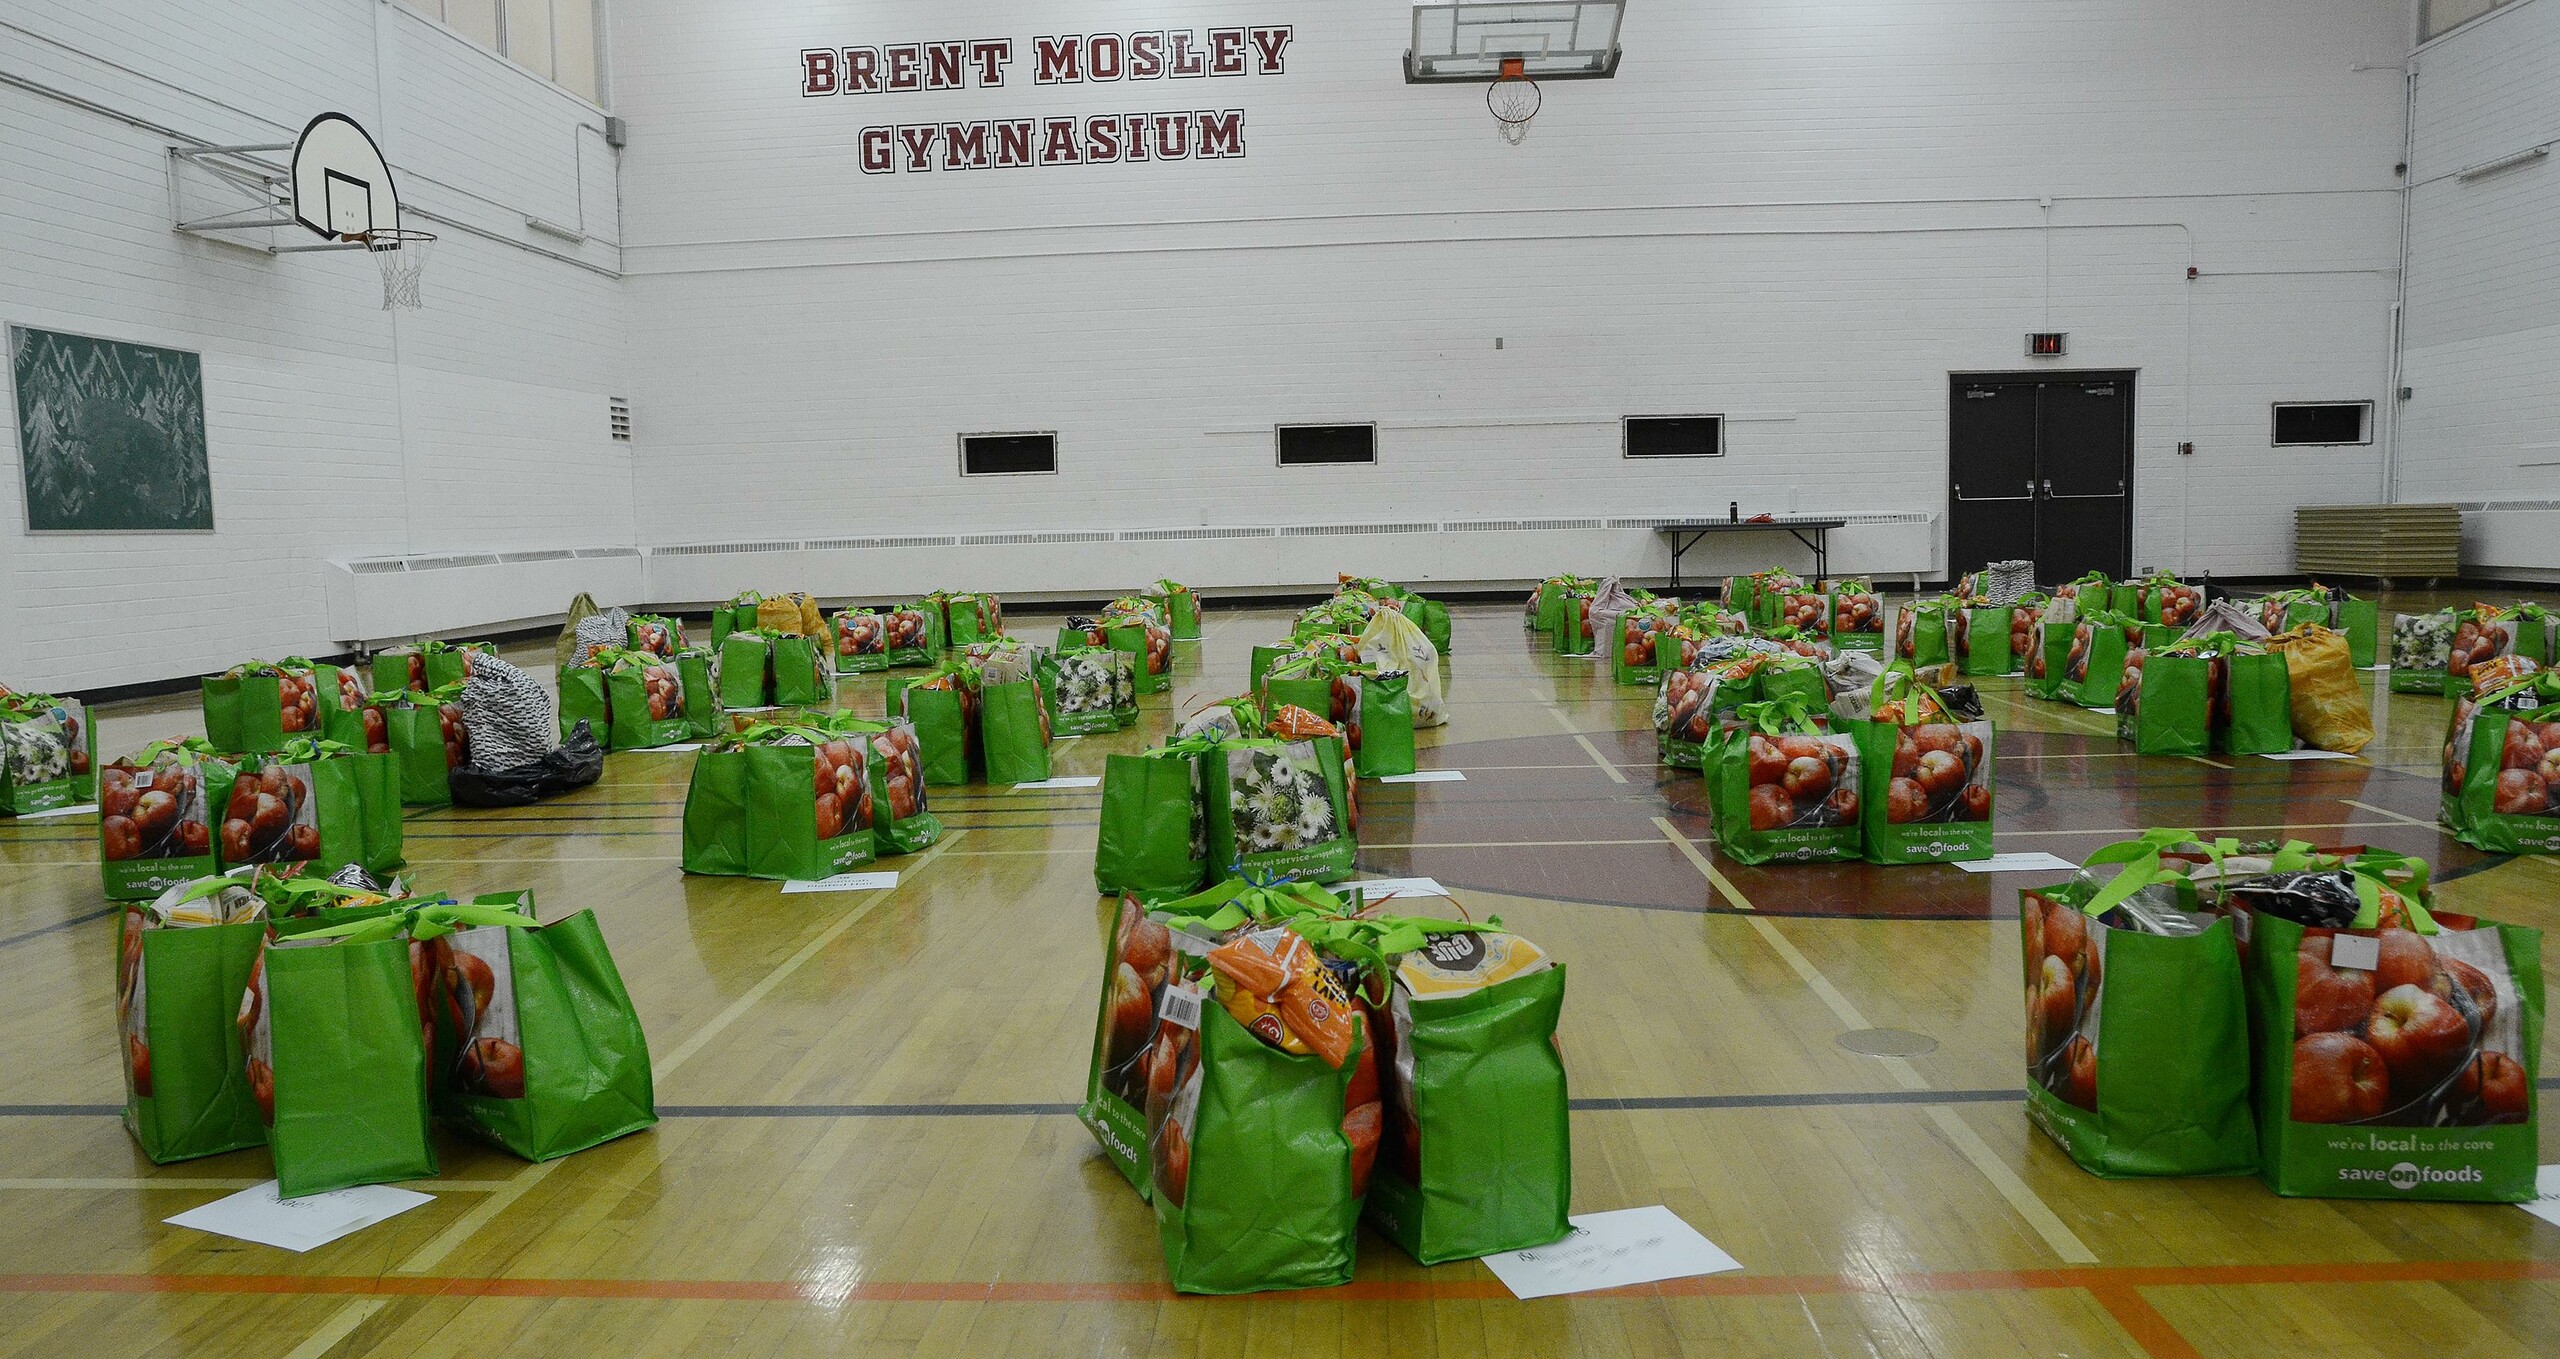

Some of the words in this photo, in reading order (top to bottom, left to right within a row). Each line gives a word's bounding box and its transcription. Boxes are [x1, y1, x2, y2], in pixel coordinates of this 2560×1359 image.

[801, 38, 1012, 98] BRENT
[1034, 25, 1293, 86] MOSLEY
[858, 109, 1246, 174] GYMNASIUM
[1787, 832, 1810, 843] local
[1919, 826, 1942, 838] local
[137, 862, 159, 873] local
[1261, 859, 1274, 869] got
[1276, 853, 1310, 866] service
[1120, 1113, 1132, 1129] the
[2328, 1137, 2365, 1150] we're
[2370, 1133, 2417, 1151] local
[2420, 1141, 2435, 1151] to
[2438, 1138, 2460, 1151] the
[2463, 1140, 2494, 1150] core
